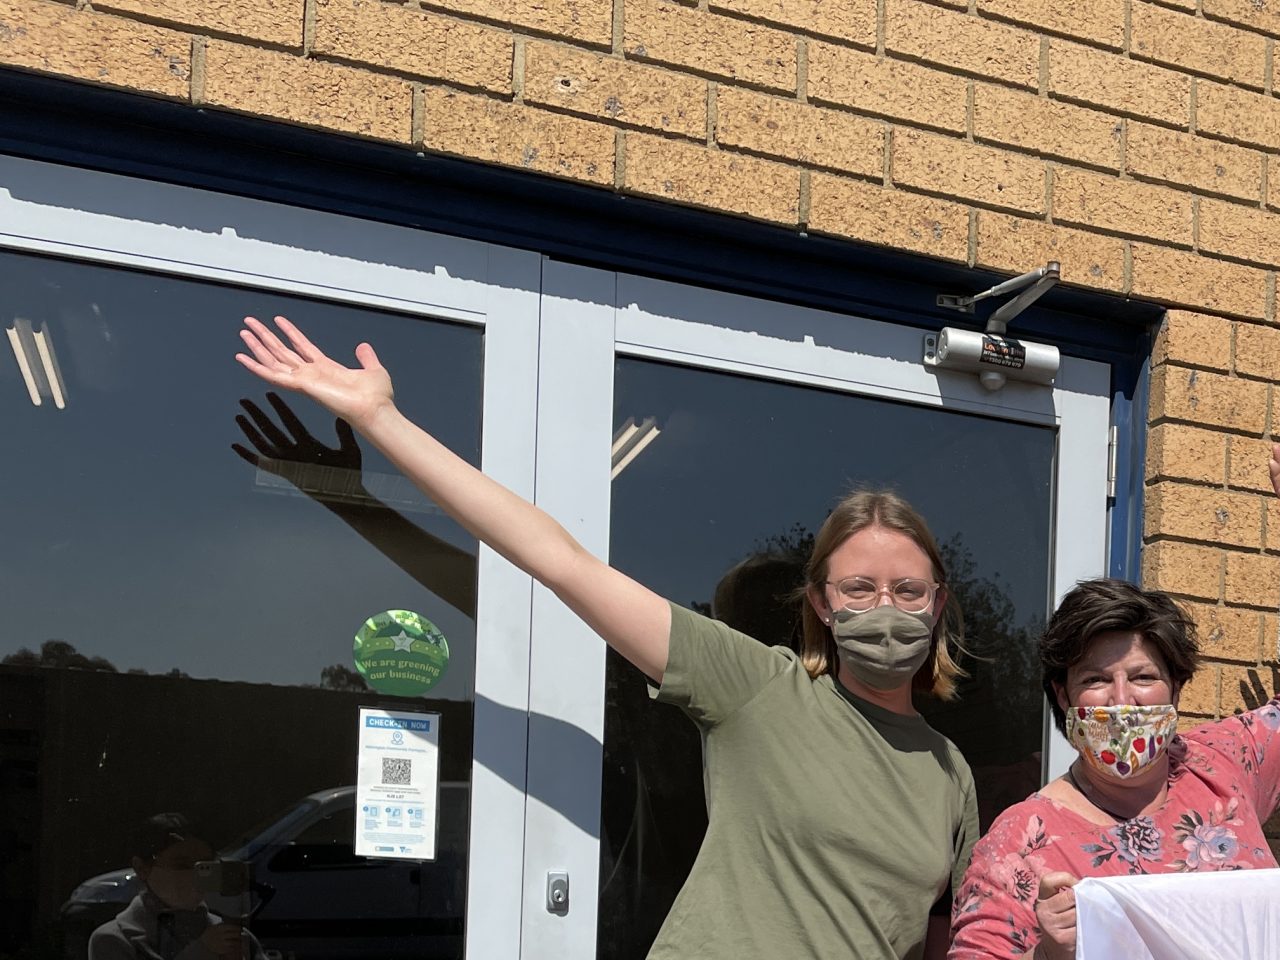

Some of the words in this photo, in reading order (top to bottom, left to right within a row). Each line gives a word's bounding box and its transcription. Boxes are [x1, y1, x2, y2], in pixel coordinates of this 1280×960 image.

[361, 659, 378, 669] We
[379, 659, 396, 667] are
[398, 659, 441, 677] greening
[370, 671, 387, 680] our
[389, 669, 432, 685] business
[369, 718, 408, 729] CHECK-IN
[410, 721, 427, 730] NOW
